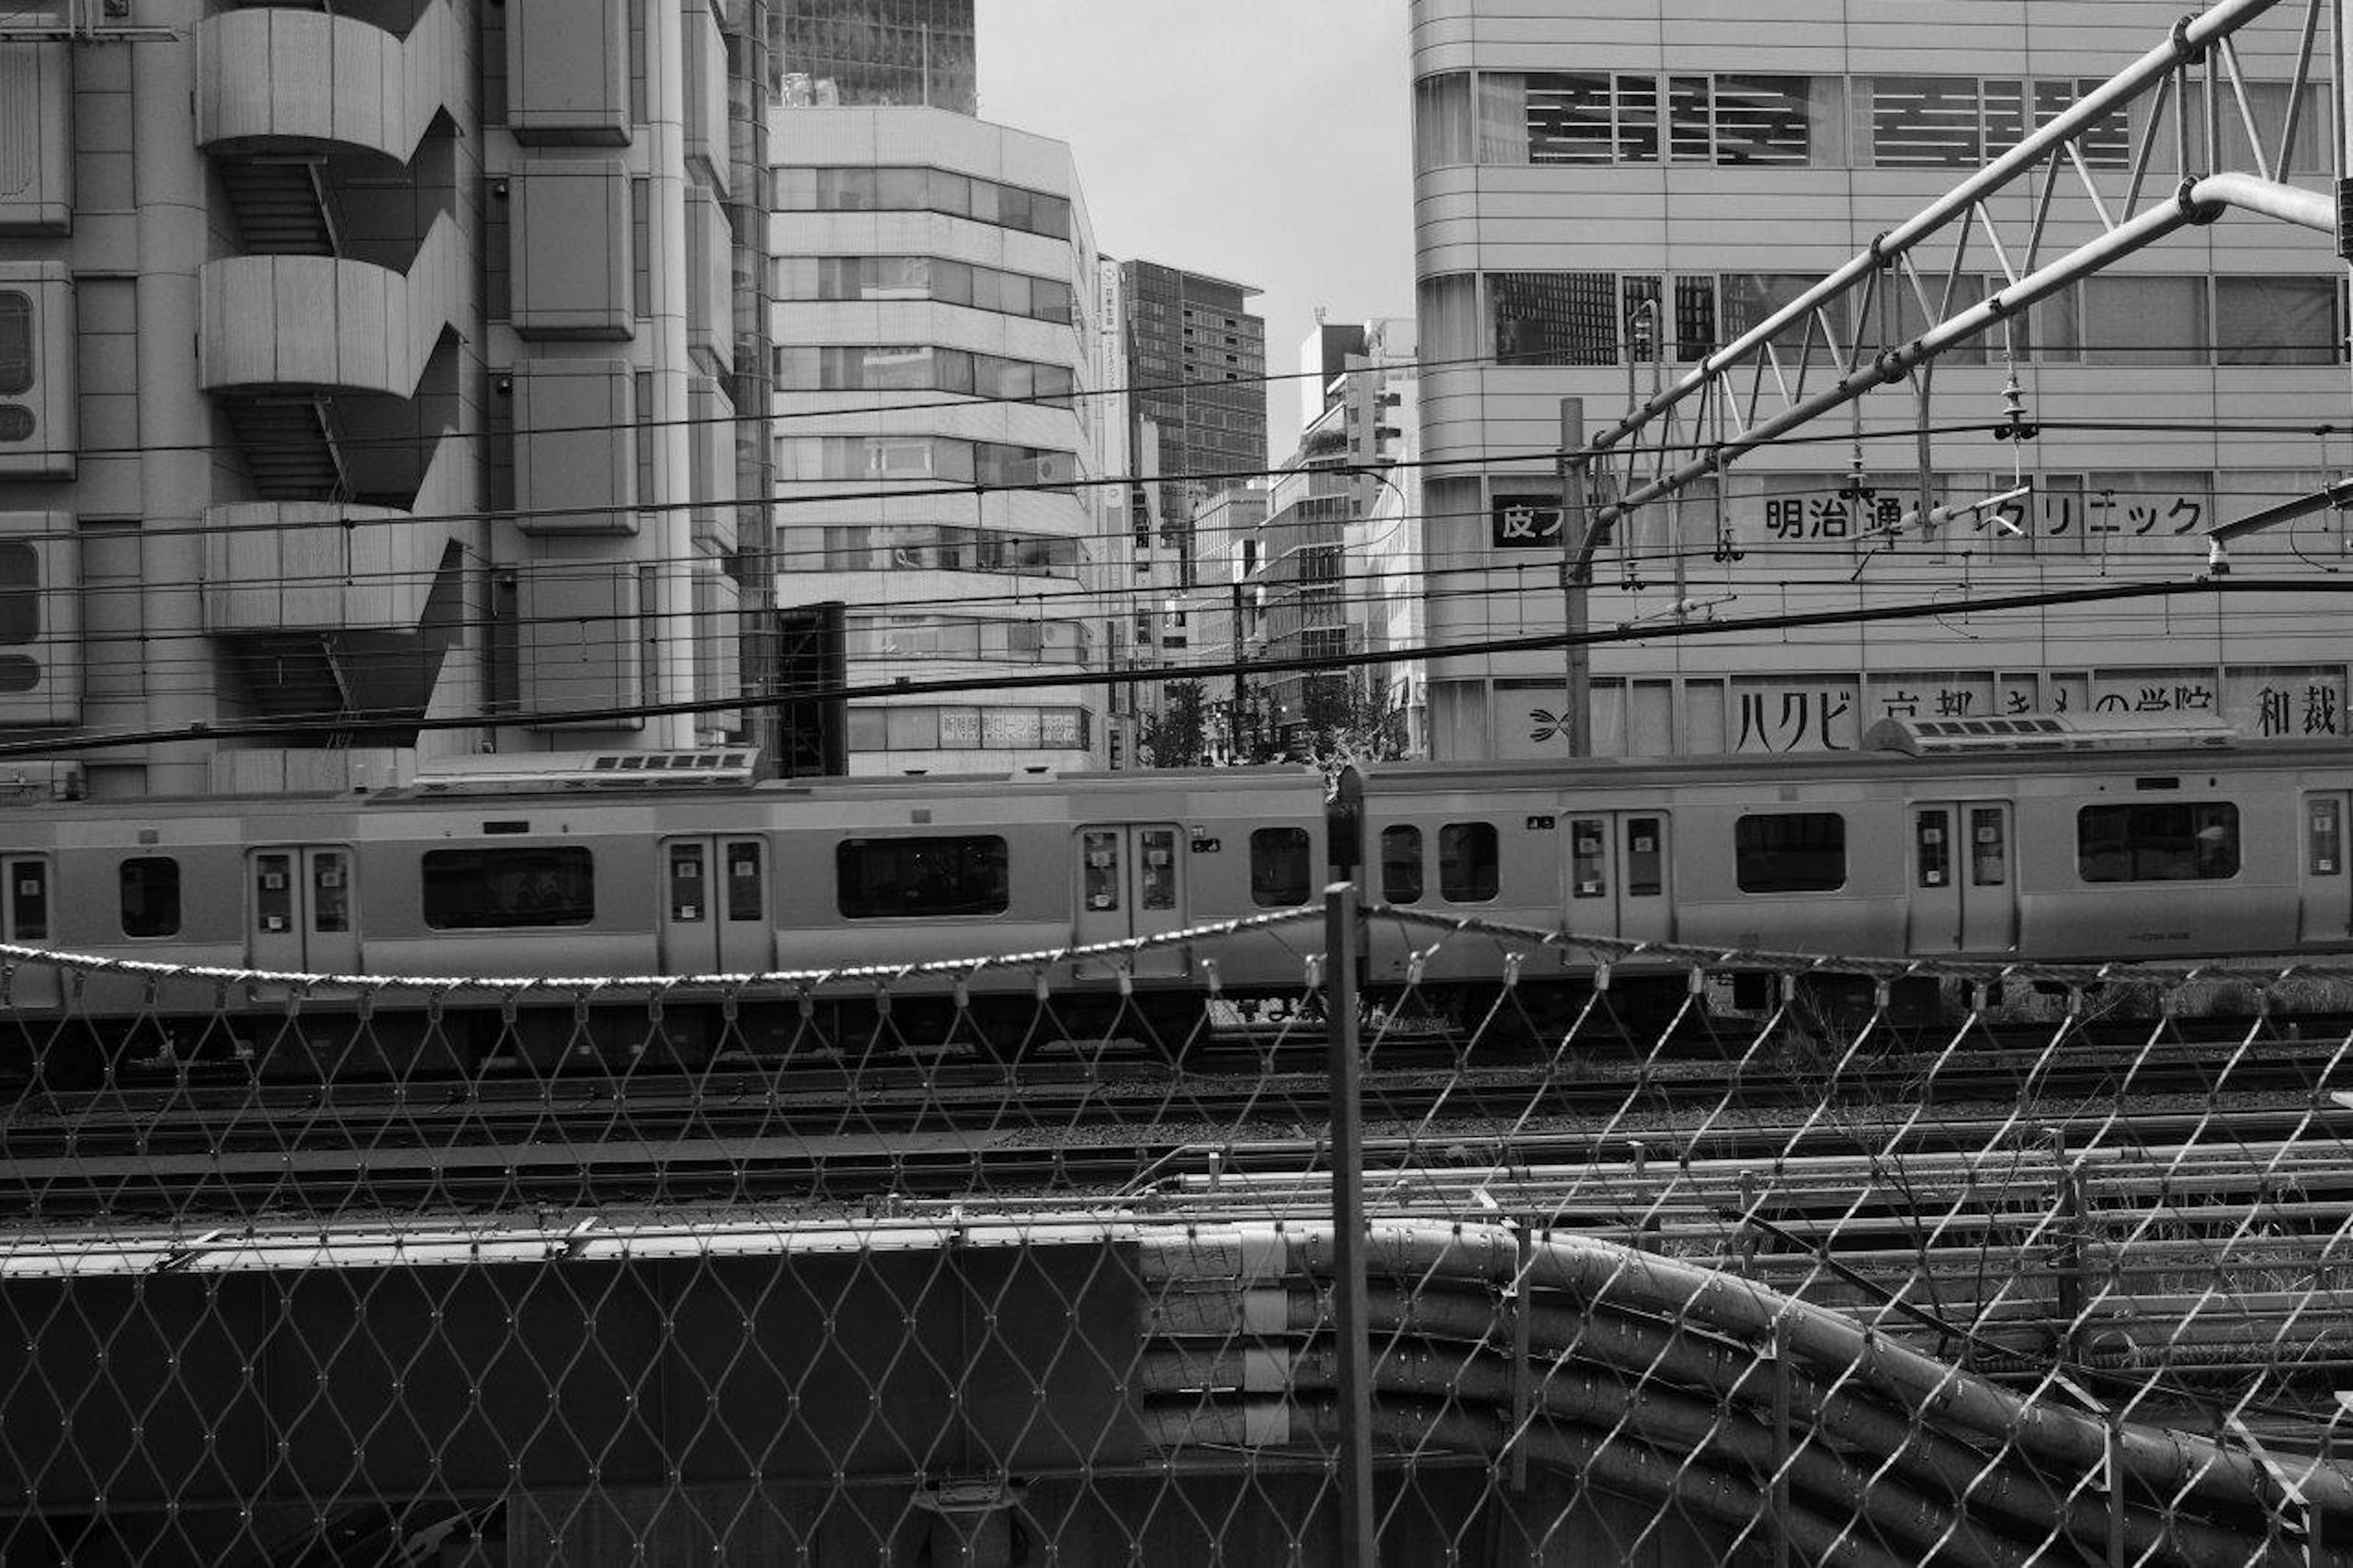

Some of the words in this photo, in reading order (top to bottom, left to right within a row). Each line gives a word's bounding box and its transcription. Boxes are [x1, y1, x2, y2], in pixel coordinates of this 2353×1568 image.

[1735, 691, 1850, 754] ハクビ
[2256, 686, 2335, 737] 和裁
